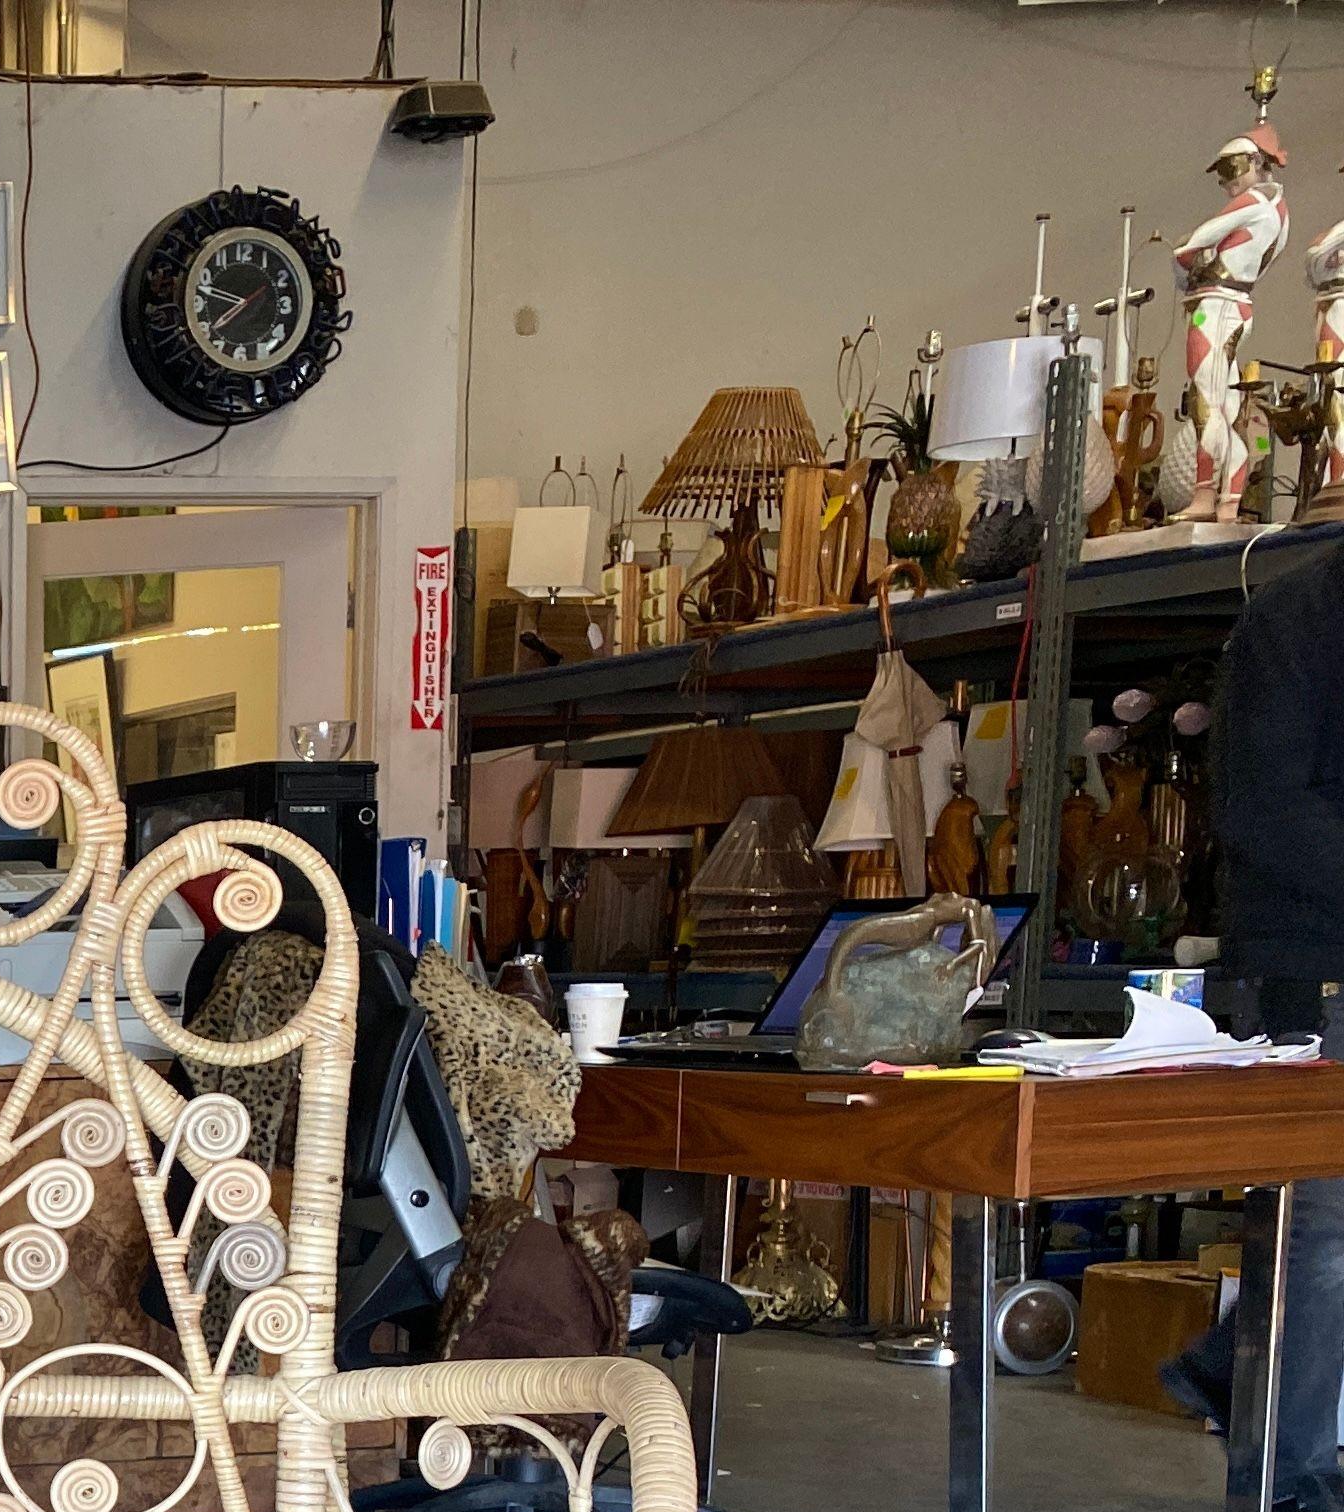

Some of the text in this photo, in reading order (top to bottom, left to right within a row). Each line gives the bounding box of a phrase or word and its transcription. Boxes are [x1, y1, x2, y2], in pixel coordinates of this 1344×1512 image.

[235, 243, 253, 262] 12
[277, 269, 289, 288] 2
[278, 295, 292, 315] 3
[418, 563, 446, 580] FIRE
[424, 586, 437, 719] EXTINGUISHER
